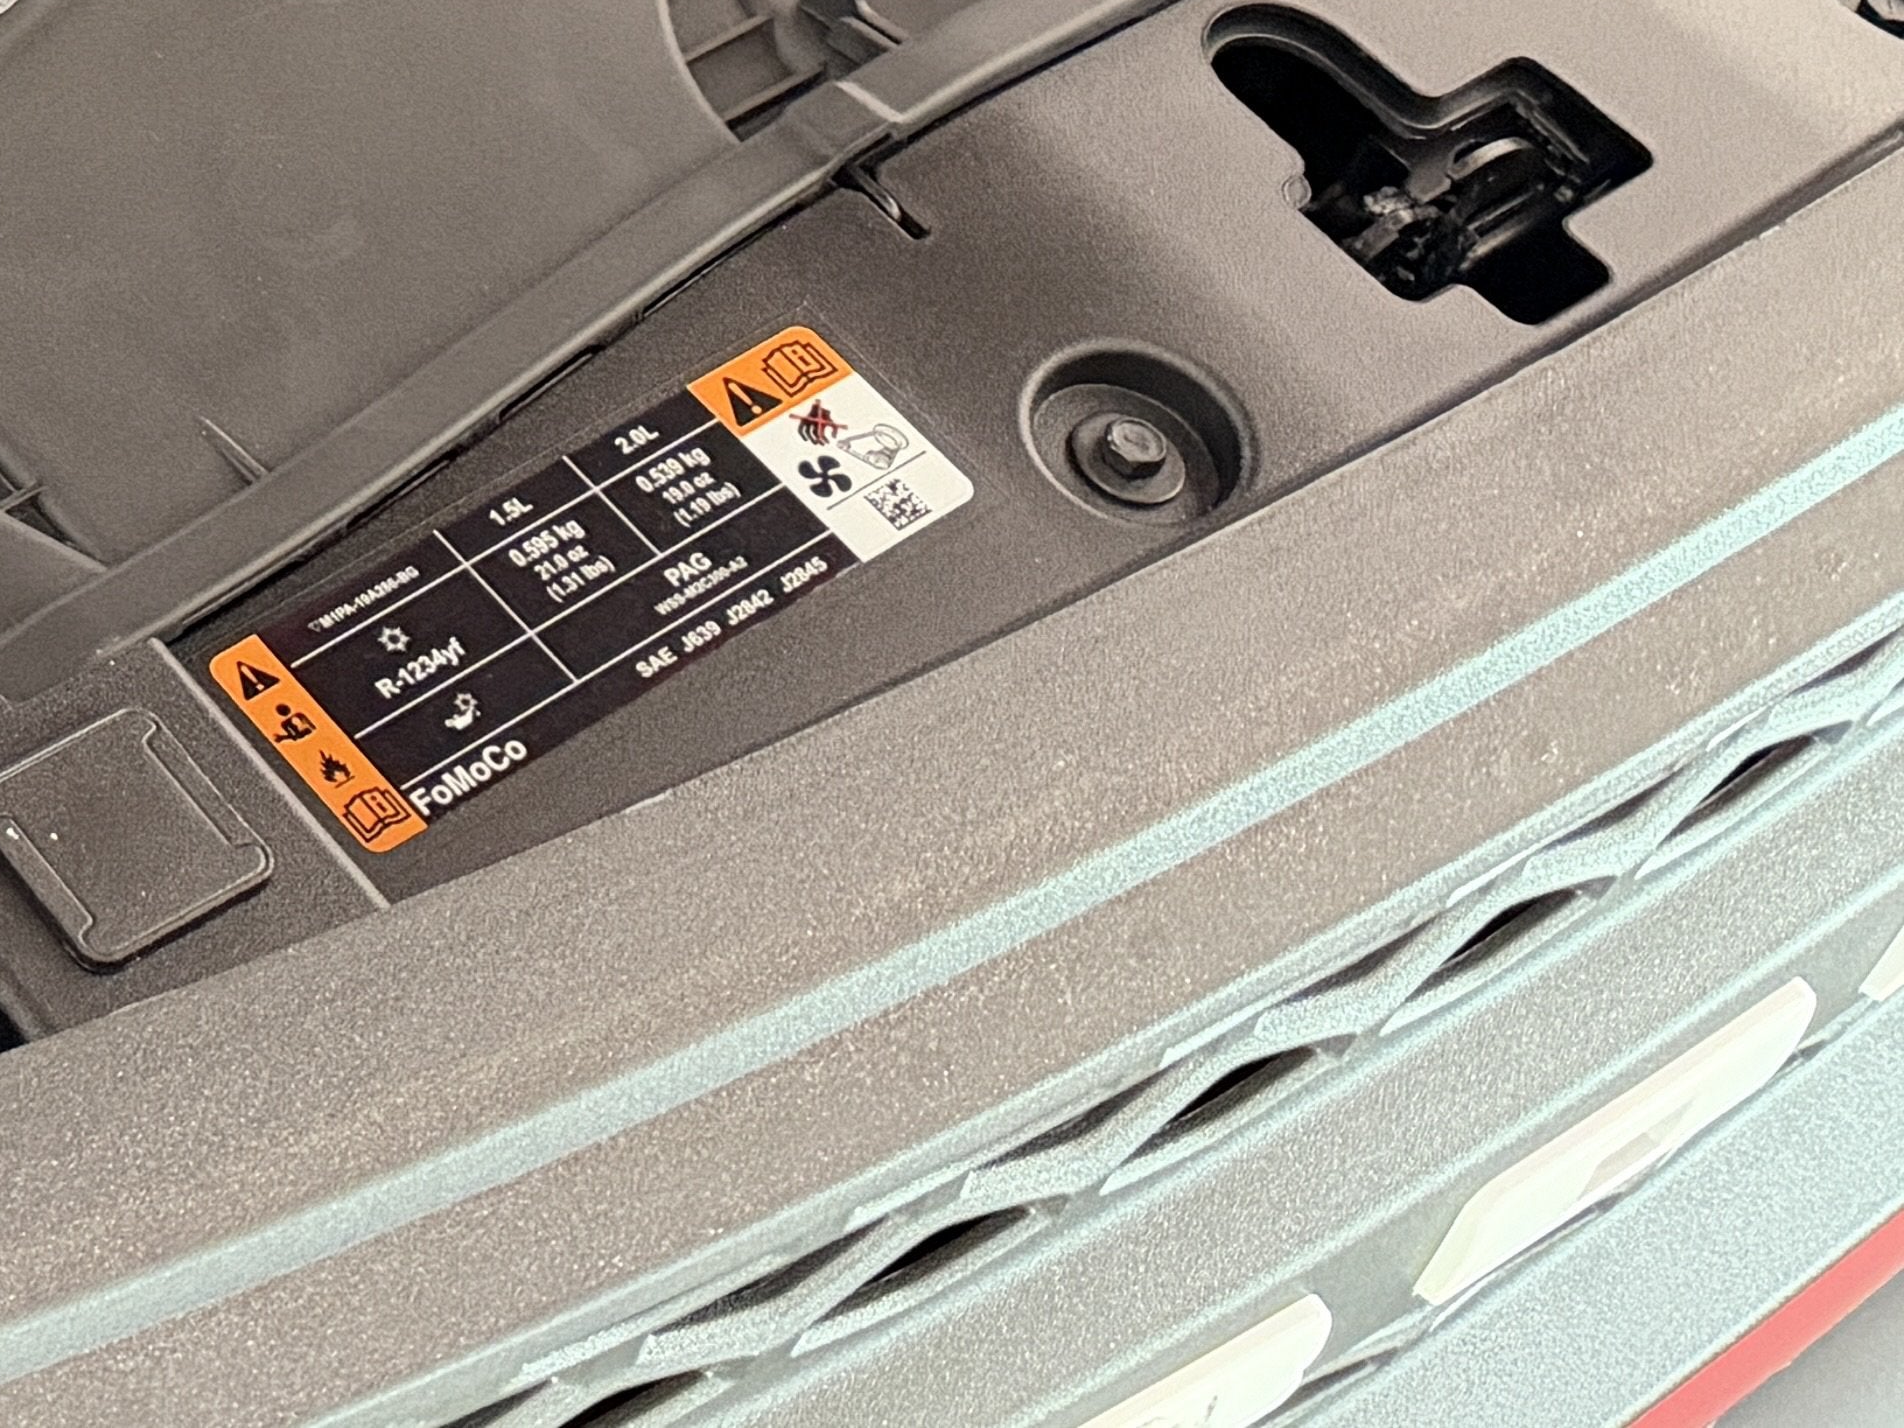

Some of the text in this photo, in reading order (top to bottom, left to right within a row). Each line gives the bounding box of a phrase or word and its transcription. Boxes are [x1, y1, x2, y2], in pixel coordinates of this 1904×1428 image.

[614, 425, 660, 455] 2.0L
[635, 447, 711, 493] 0.539 kg
[662, 472, 716, 504] 19.0 oz
[489, 497, 534, 526] 1.5L
[674, 482, 741, 528] (1.19 lbs)
[508, 520, 586, 567] 0.595 kg
[534, 545, 589, 581] 21.0 oz
[546, 555, 616, 603] (1.31 lbs)
[663, 552, 713, 587] PAG
[635, 556, 828, 678] SAE J639 J2842 J2845
[374, 636, 466, 699] R-1234yf
[408, 739, 528, 817] FoMoCo
